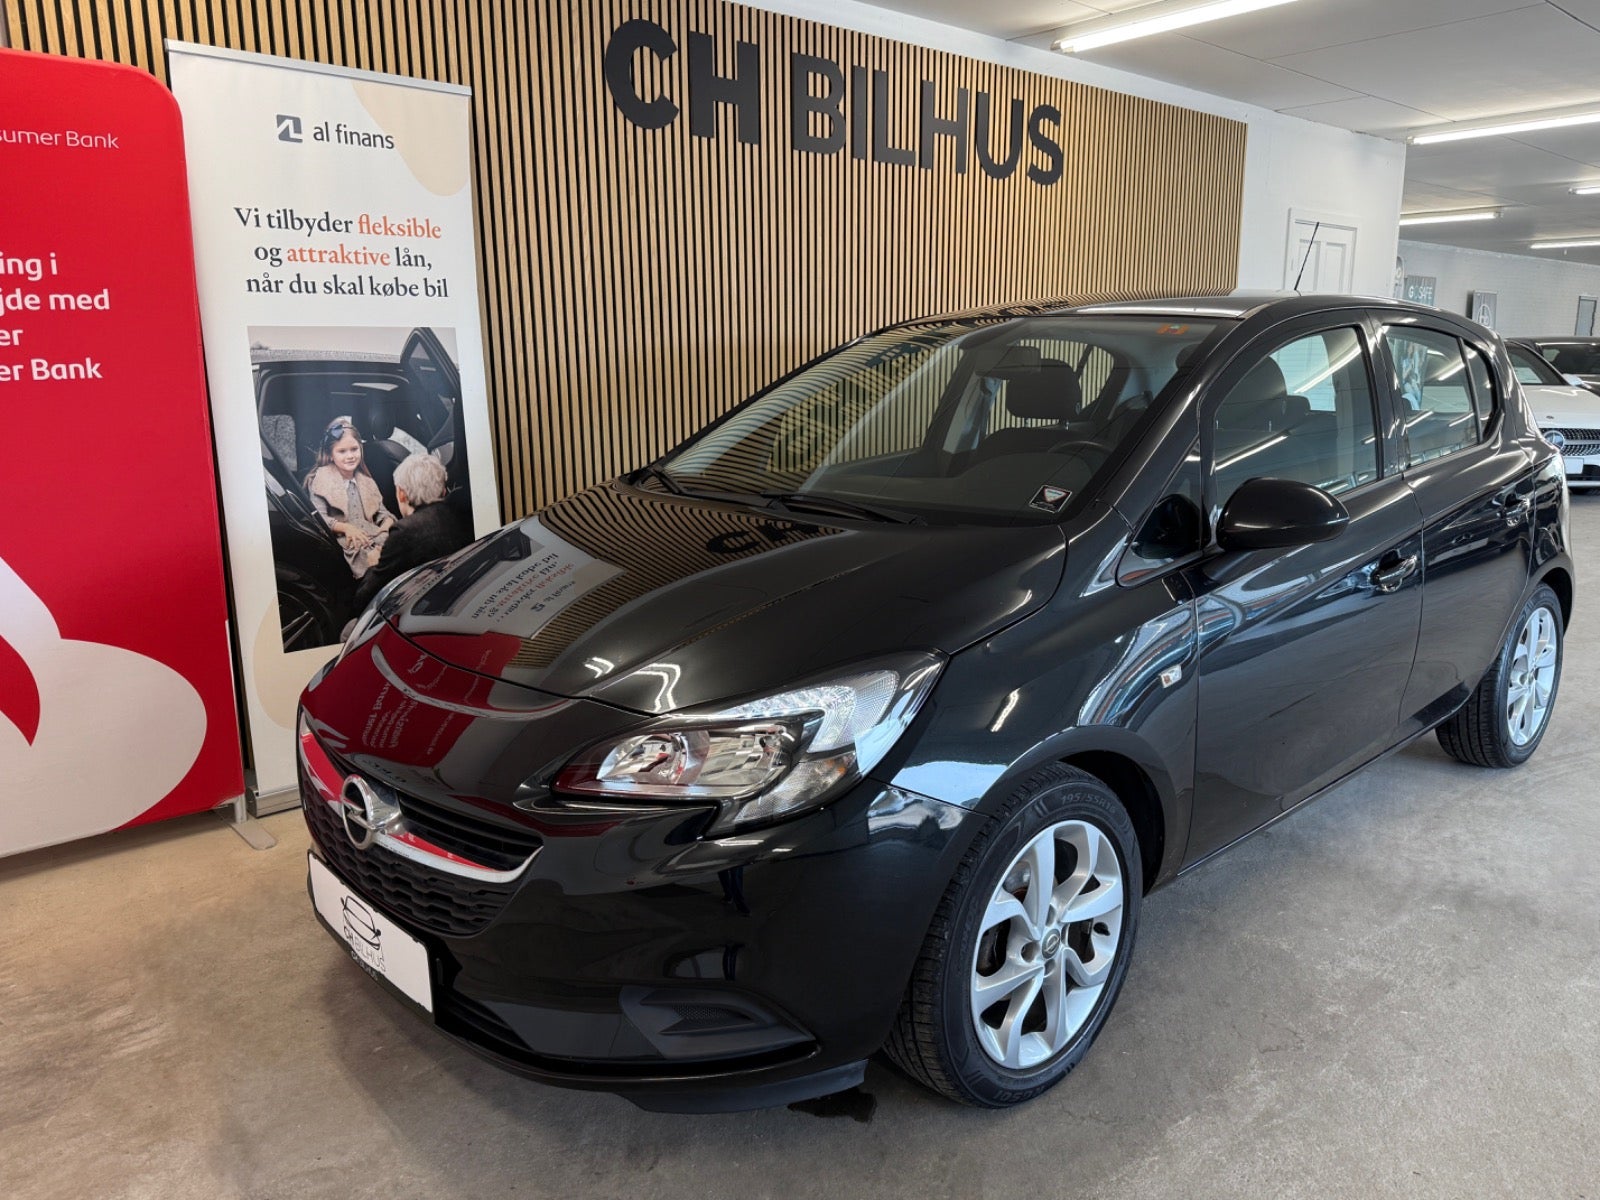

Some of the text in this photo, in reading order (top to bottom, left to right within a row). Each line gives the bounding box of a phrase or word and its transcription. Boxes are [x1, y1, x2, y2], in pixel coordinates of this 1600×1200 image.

[605, 18, 1064, 186] CH BILHUS
[66, 130, 119, 149] Bank
[313, 121, 395, 150] al finans
[233, 206, 442, 239] Vi tilbyder fleksible
[49, 252, 58, 275] i
[254, 243, 432, 271] og attraktive lån,
[246, 272, 449, 298] når du skal købe bil
[48, 288, 110, 311] med
[30, 357, 103, 381] Bank
